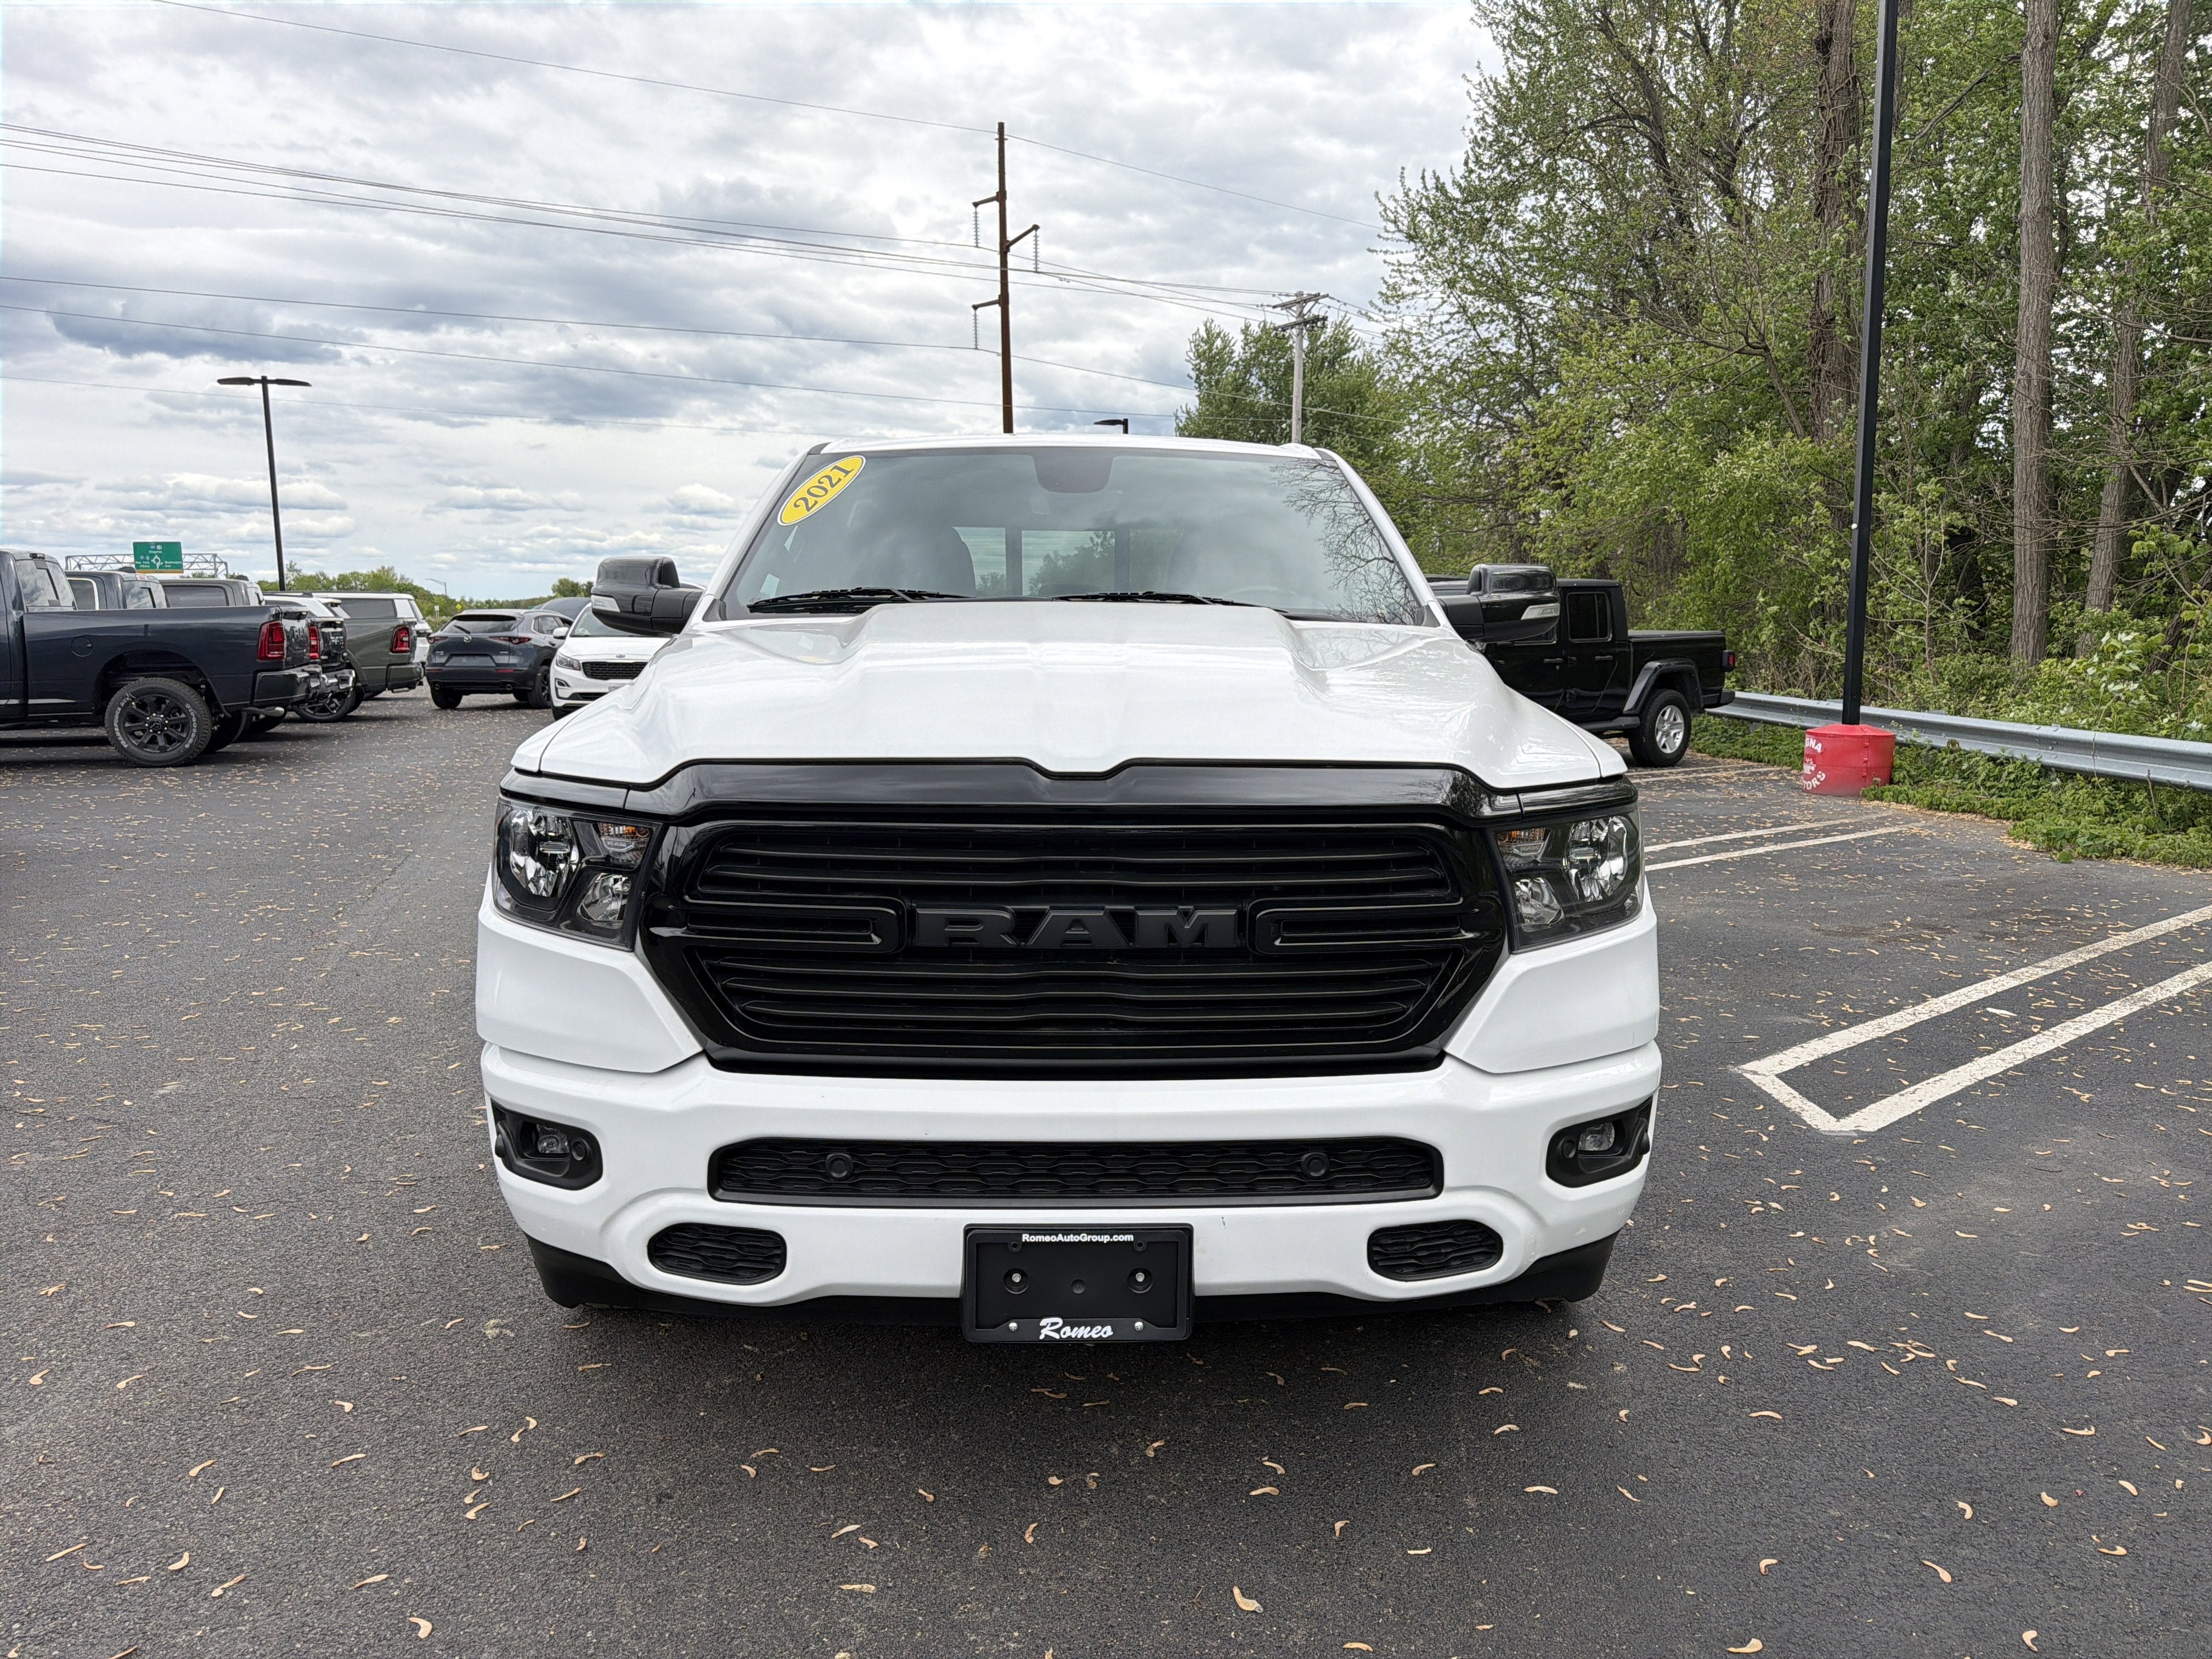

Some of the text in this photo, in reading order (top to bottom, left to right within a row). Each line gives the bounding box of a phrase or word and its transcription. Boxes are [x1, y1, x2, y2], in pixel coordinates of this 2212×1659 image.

[793, 465, 854, 512] 2021
[916, 908, 1238, 948] RAM
[1022, 1233, 1134, 1244] RomeoAutoGroup.com
[1039, 1317, 1114, 1340] Romeo
